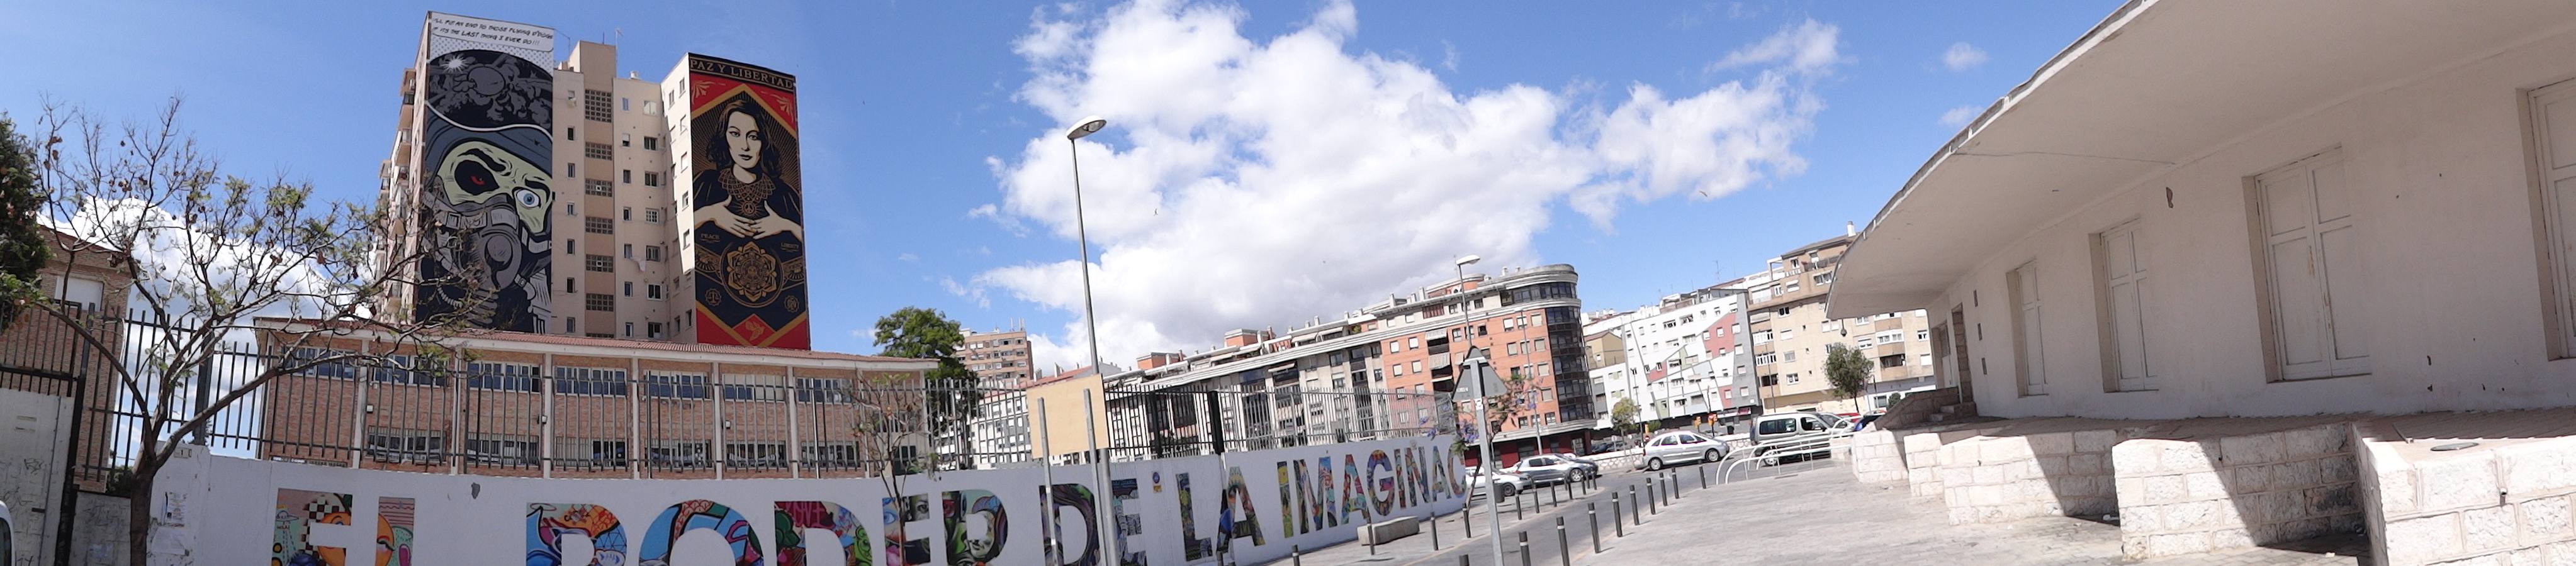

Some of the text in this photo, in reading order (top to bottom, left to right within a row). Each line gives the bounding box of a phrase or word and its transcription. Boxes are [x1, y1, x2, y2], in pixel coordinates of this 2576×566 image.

[509, 27, 531, 36] FLYING
[690, 59, 793, 89] PAZ Y LIBERTAD
[1175, 466, 1266, 562] LA
